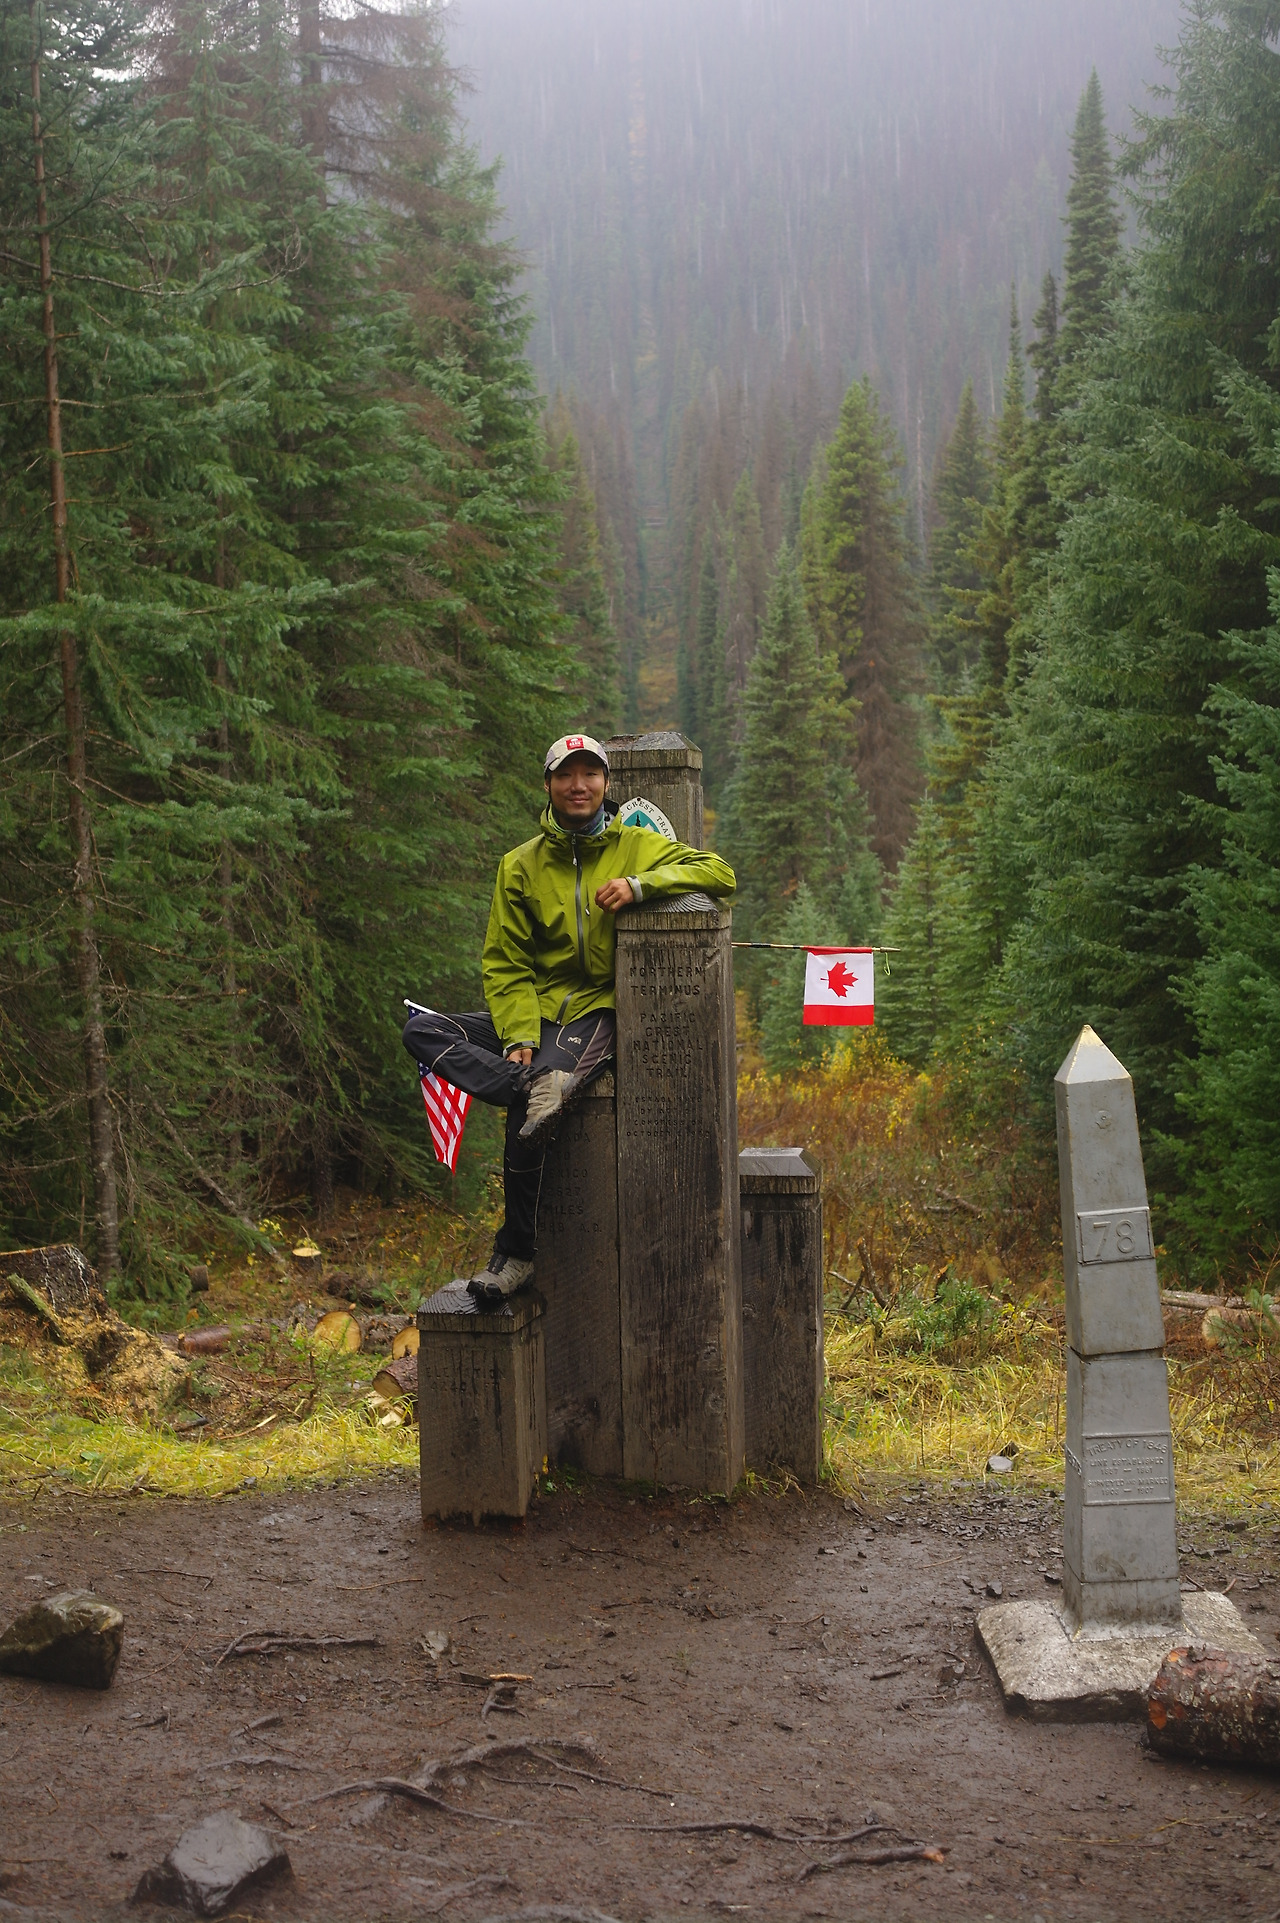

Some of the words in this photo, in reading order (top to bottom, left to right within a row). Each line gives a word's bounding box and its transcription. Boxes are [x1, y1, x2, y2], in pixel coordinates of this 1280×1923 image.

[627, 801, 655, 814] CREST
[656, 815, 672, 841] TRAI
[629, 966, 704, 977] NORTHERN
[630, 985, 701, 996] TERMINUS
[640, 1012, 696, 1023] PACIFIC
[645, 1026, 690, 1037] CREST
[633, 1040, 704, 1052] NATIONAL
[642, 1054, 692, 1065] SCENIC
[646, 1068, 688, 1079] TRAIL
[1093, 1219, 1136, 1258] 78
[1087, 1440, 1122, 1457] TREATY
[1126, 1439, 1140, 1448] OF
[1090, 1458, 1108, 1467] LINE
[1112, 1456, 1165, 1467] ESTABLISHED
[1087, 1478, 1125, 1488] SURVEYED
[1138, 1477, 1168, 1487] MARKED
